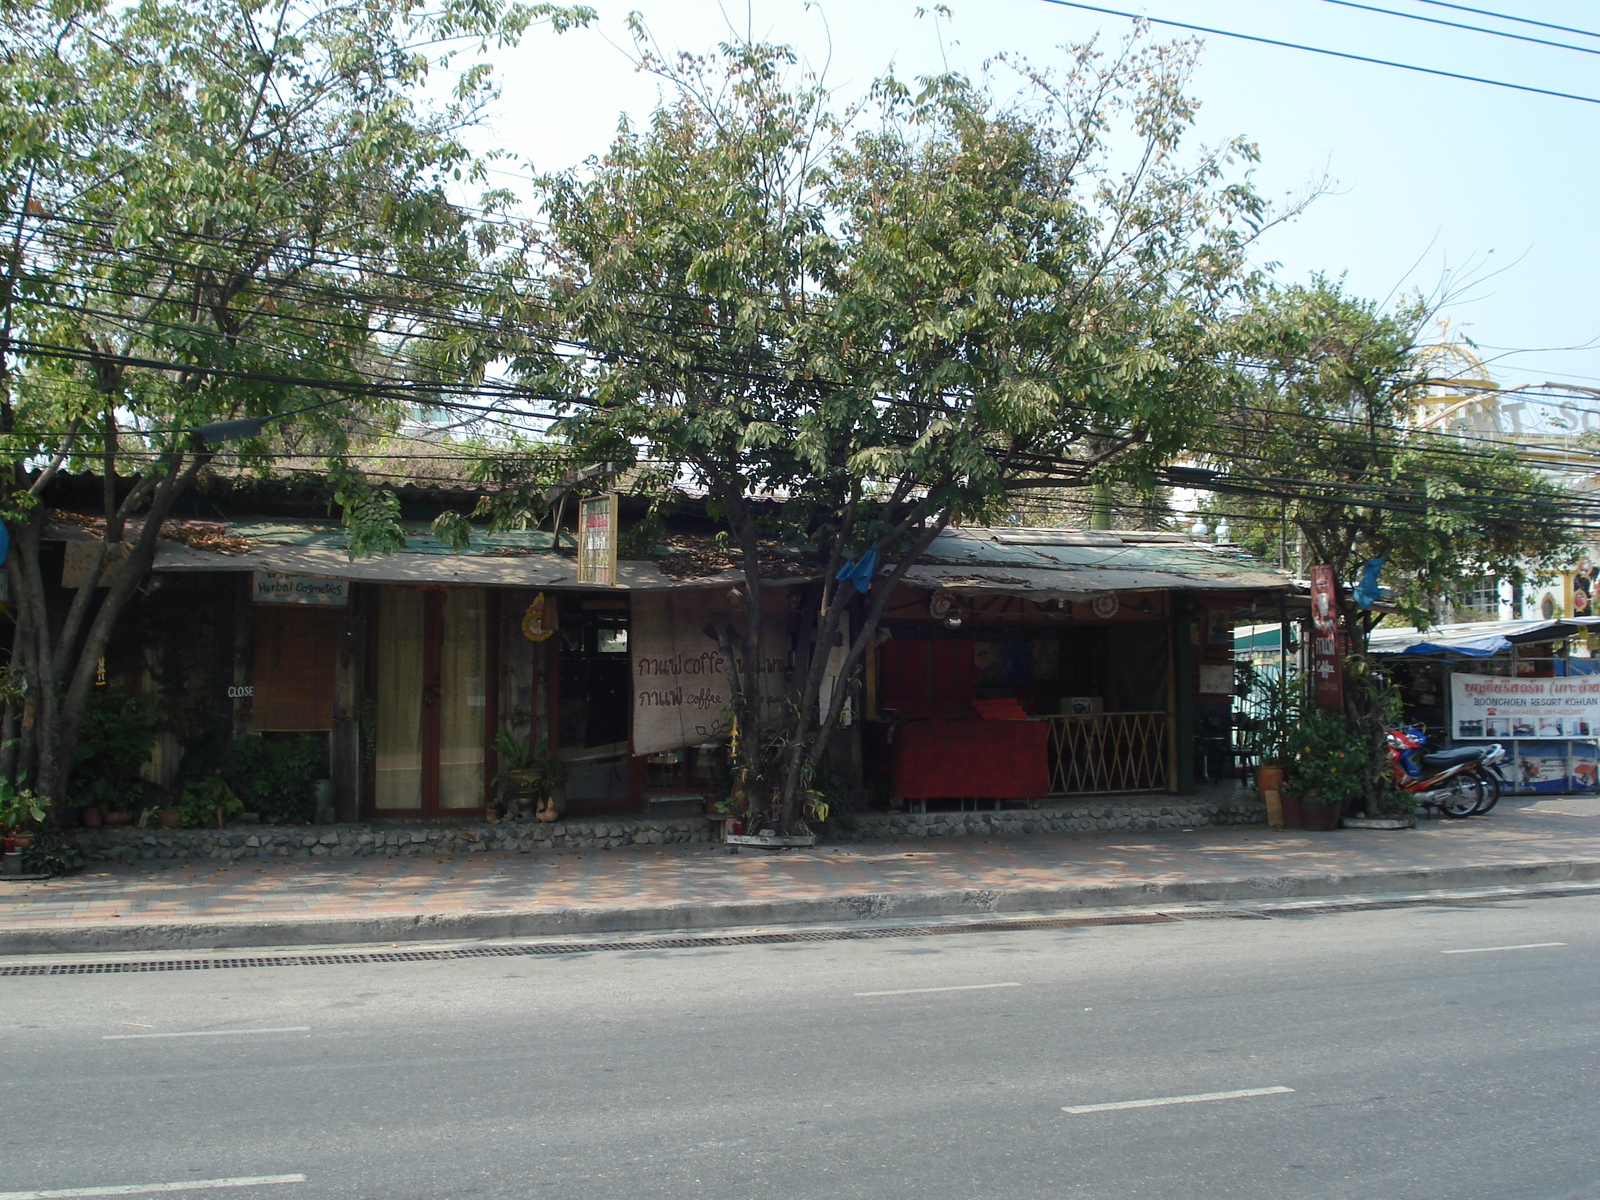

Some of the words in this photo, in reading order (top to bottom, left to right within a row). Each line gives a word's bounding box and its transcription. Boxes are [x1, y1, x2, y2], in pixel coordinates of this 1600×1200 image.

[258, 582, 292, 592] Herbal
[296, 583, 341, 595] Cosmetics
[638, 654, 682, 675] กาแฟ
[684, 651, 726, 674] coffe
[228, 686, 254, 697] CLOSE
[686, 688, 722, 710] coffee
[1474, 698, 1527, 706] BOONCHOEN
[1531, 698, 1562, 706] RESORT
[1566, 698, 1598, 706] KOHLAN
